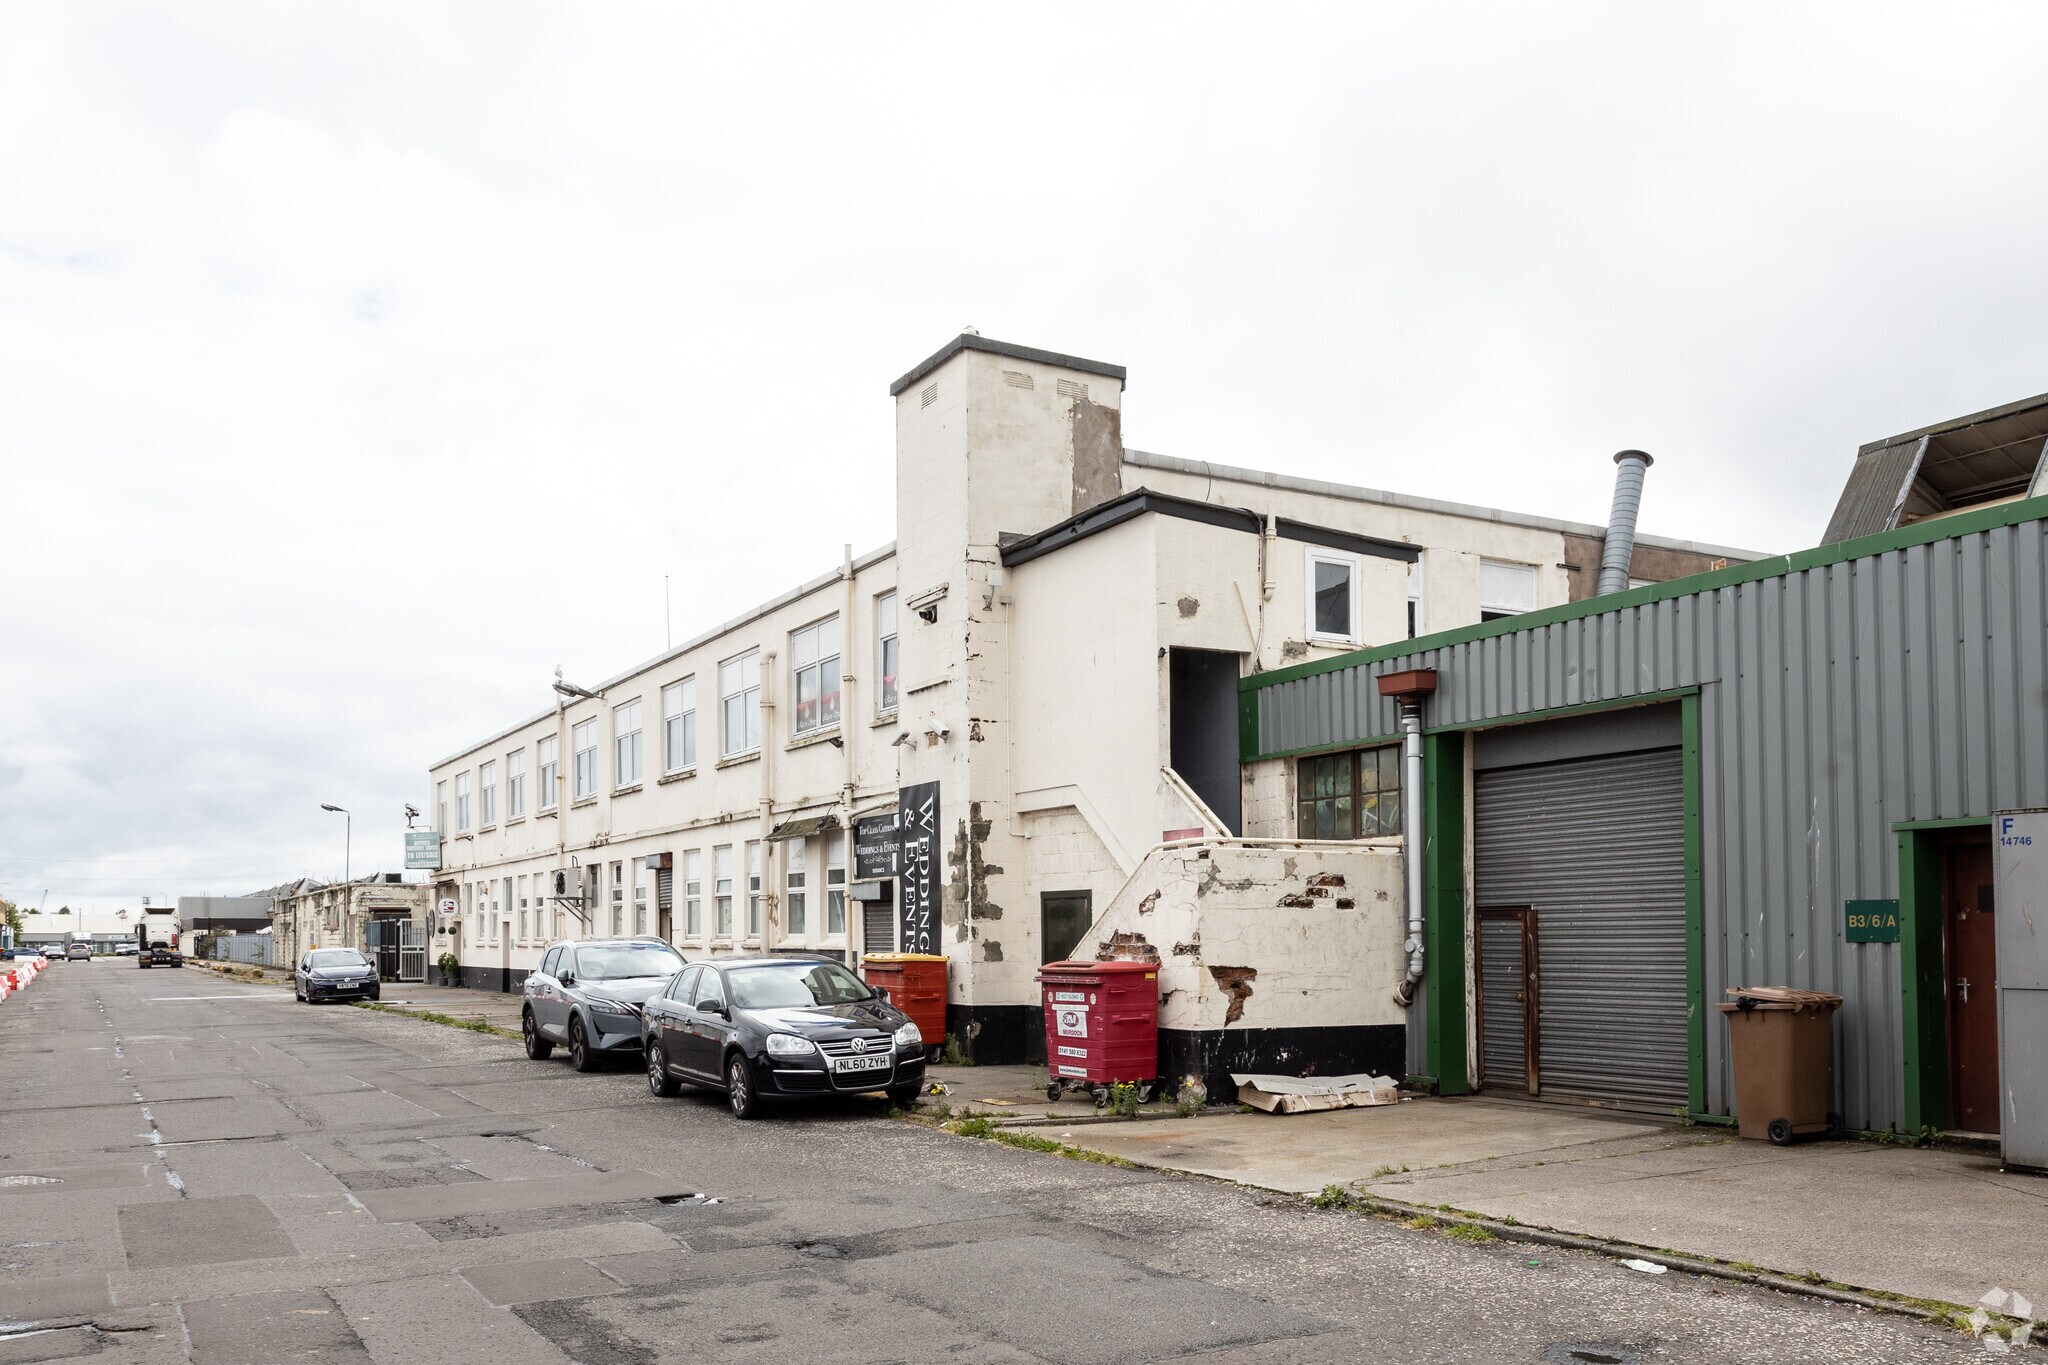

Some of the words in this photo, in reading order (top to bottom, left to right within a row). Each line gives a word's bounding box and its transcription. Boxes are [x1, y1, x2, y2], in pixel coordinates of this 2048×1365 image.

[904, 808, 915, 830] &
[2002, 818, 2014, 835] F
[884, 841, 900, 852] EVENTS
[2000, 836, 2032, 846] 14746
[415, 851, 439, 859] LET/SALE
[919, 792, 935, 954] WEDDING
[904, 840, 920, 954] EVENTS
[1848, 913, 1896, 929] B3/6/A
[1062, 1029, 1083, 1037] MURDOCH
[840, 1059, 866, 1071] NL60
[868, 1056, 886, 1068] ZYH
